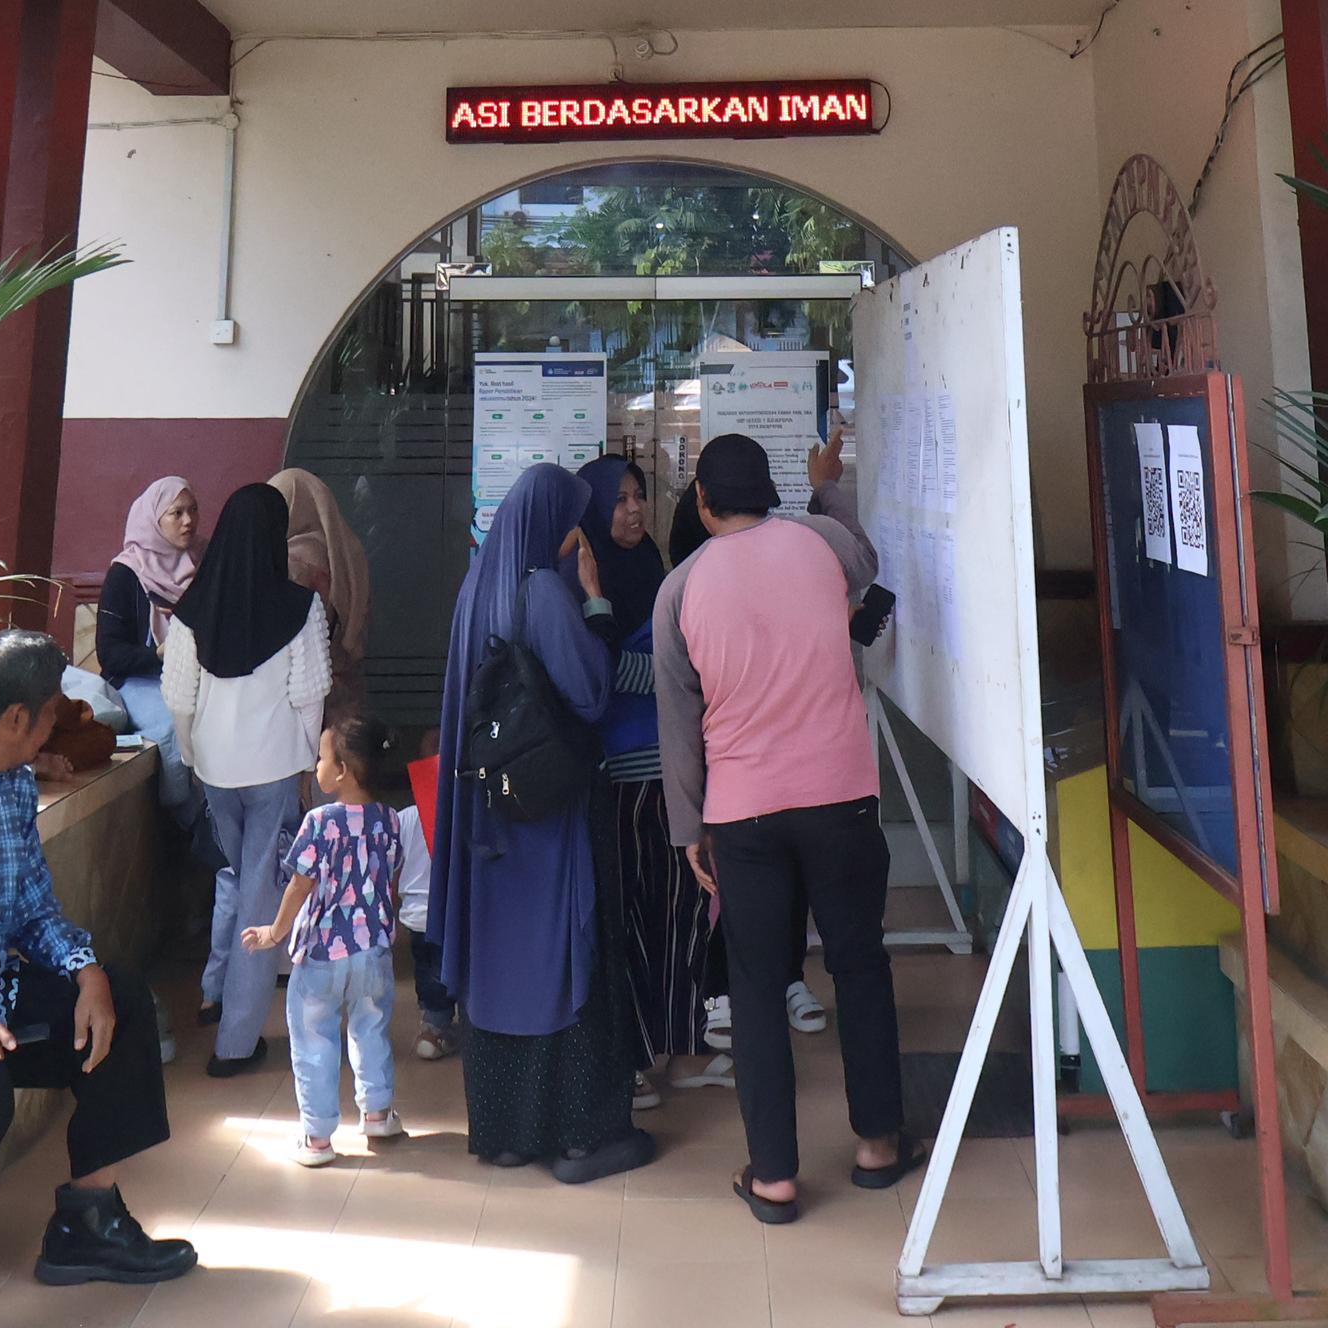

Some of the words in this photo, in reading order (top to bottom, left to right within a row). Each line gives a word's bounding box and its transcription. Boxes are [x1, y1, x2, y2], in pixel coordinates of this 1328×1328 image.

[451, 100, 511, 129] ASI
[520, 95, 769, 128] BERDASARKAN
[778, 93, 867, 122] IMAN
[678, 436, 686, 480] DORONG
